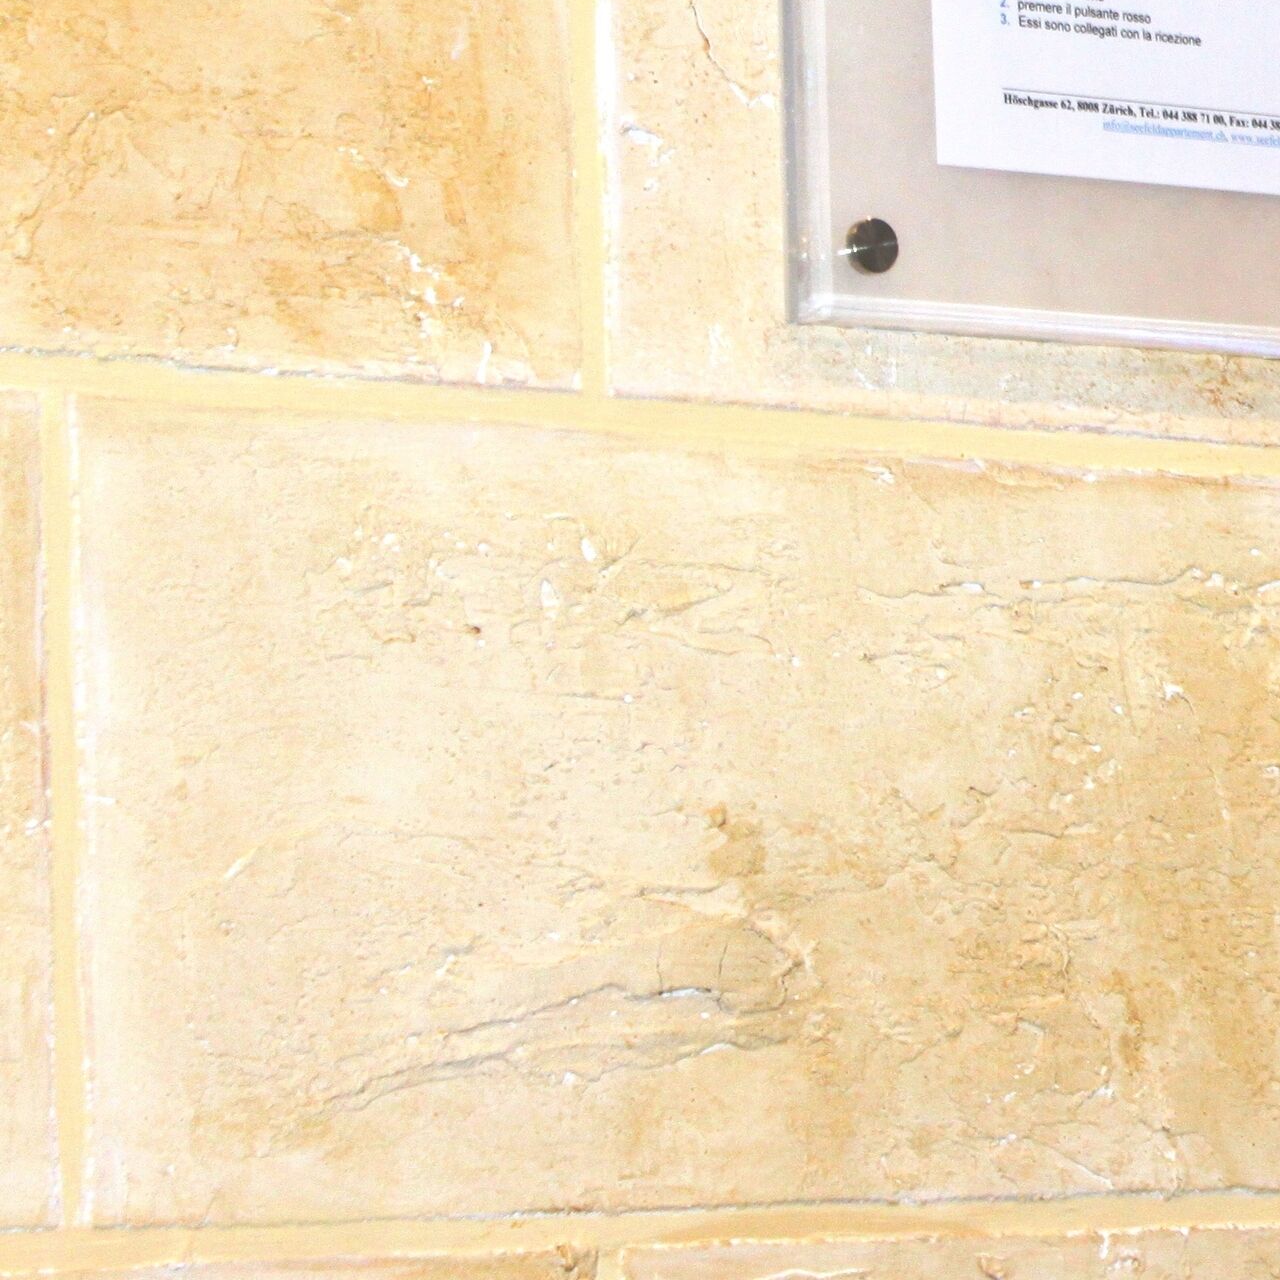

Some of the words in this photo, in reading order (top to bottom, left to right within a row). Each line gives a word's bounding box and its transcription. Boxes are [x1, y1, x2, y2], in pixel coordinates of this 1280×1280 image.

[1017, 1, 1063, 15] premere
[1066, 3, 1071, 16] il
[1074, 5, 1119, 22] pulsante
[1123, 12, 1151, 25] rosso
[1000, 13, 1010, 26] 3.
[1018, 15, 1041, 29] Essi
[1044, 19, 1071, 33] sono
[1074, 23, 1118, 40] collegati
[1120, 28, 1140, 40] con
[1143, 28, 1152, 41] la
[1155, 32, 1202, 47] ricezione
